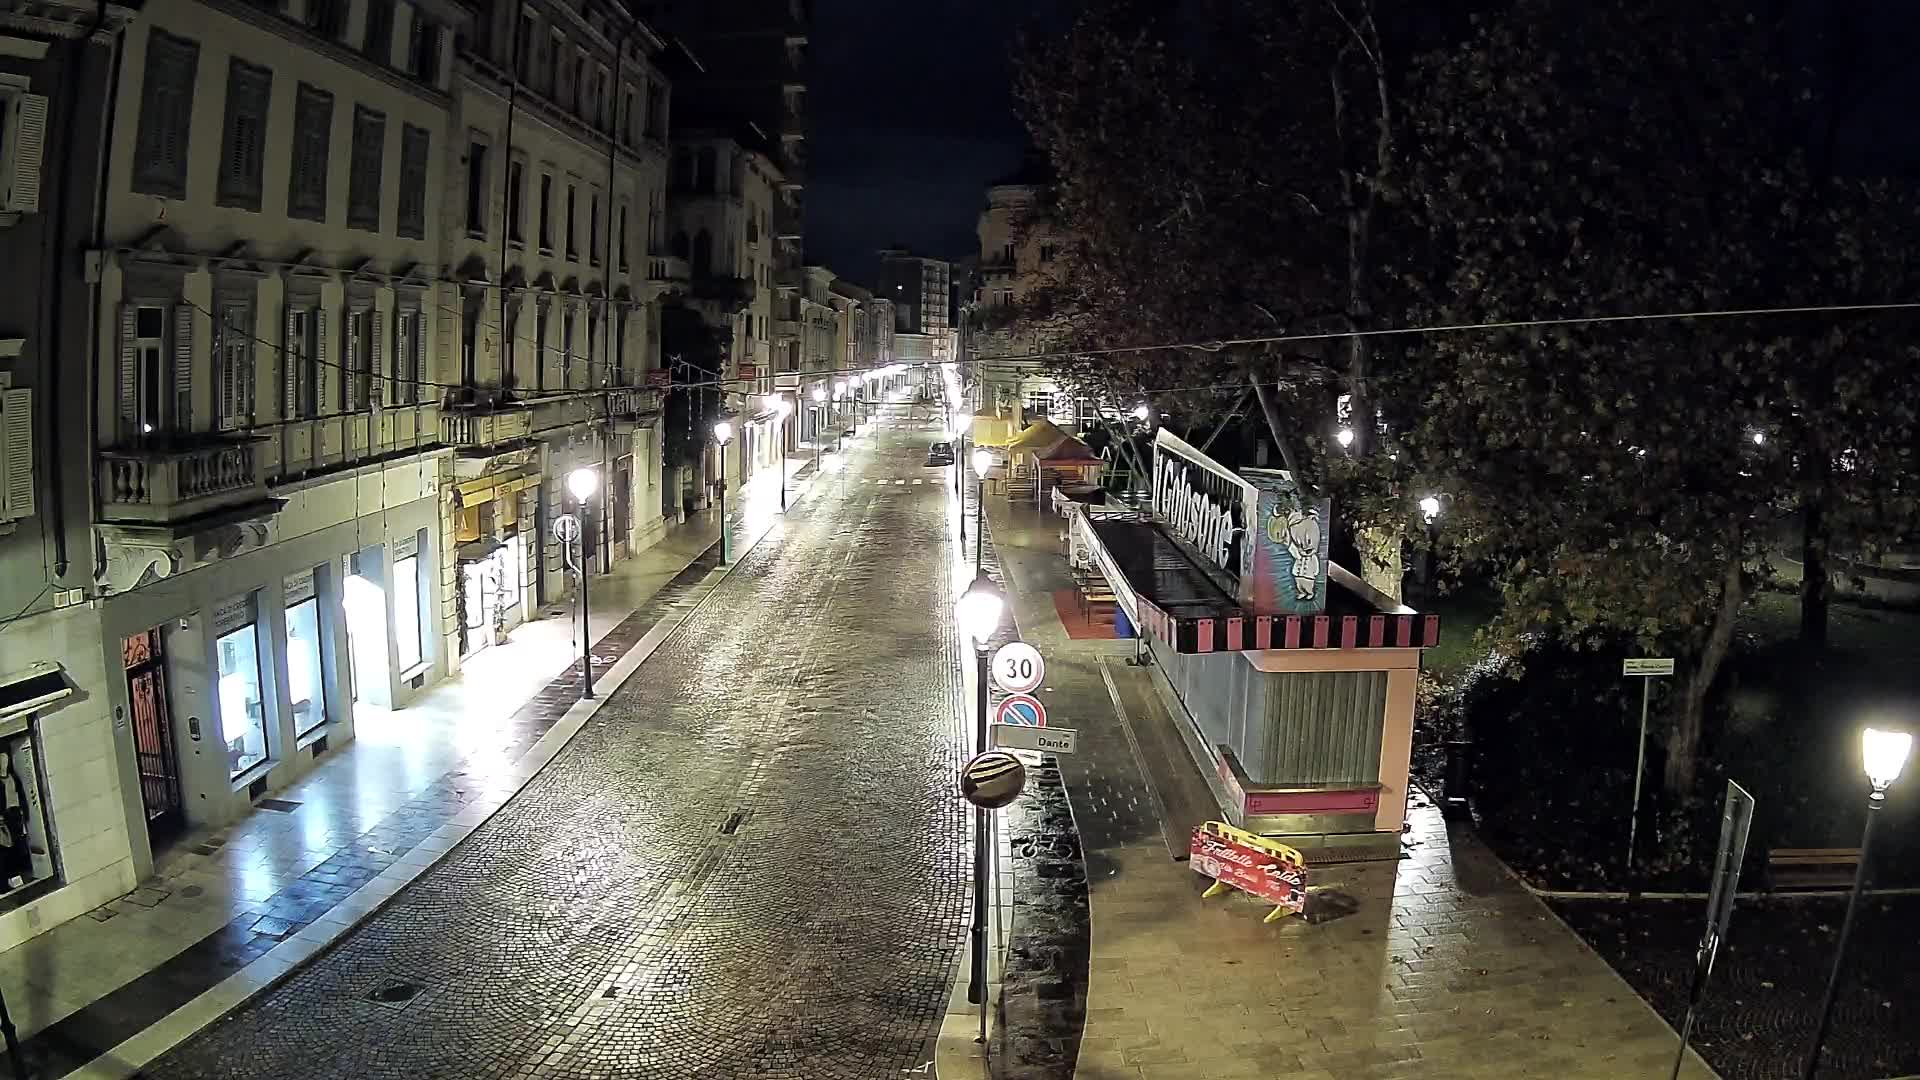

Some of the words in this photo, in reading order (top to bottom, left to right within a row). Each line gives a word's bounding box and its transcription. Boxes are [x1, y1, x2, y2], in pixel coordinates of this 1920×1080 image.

[1162, 458, 1233, 570] Golosone
[1006, 658, 1032, 679] 30
[1038, 737, 1070, 749] Dante
